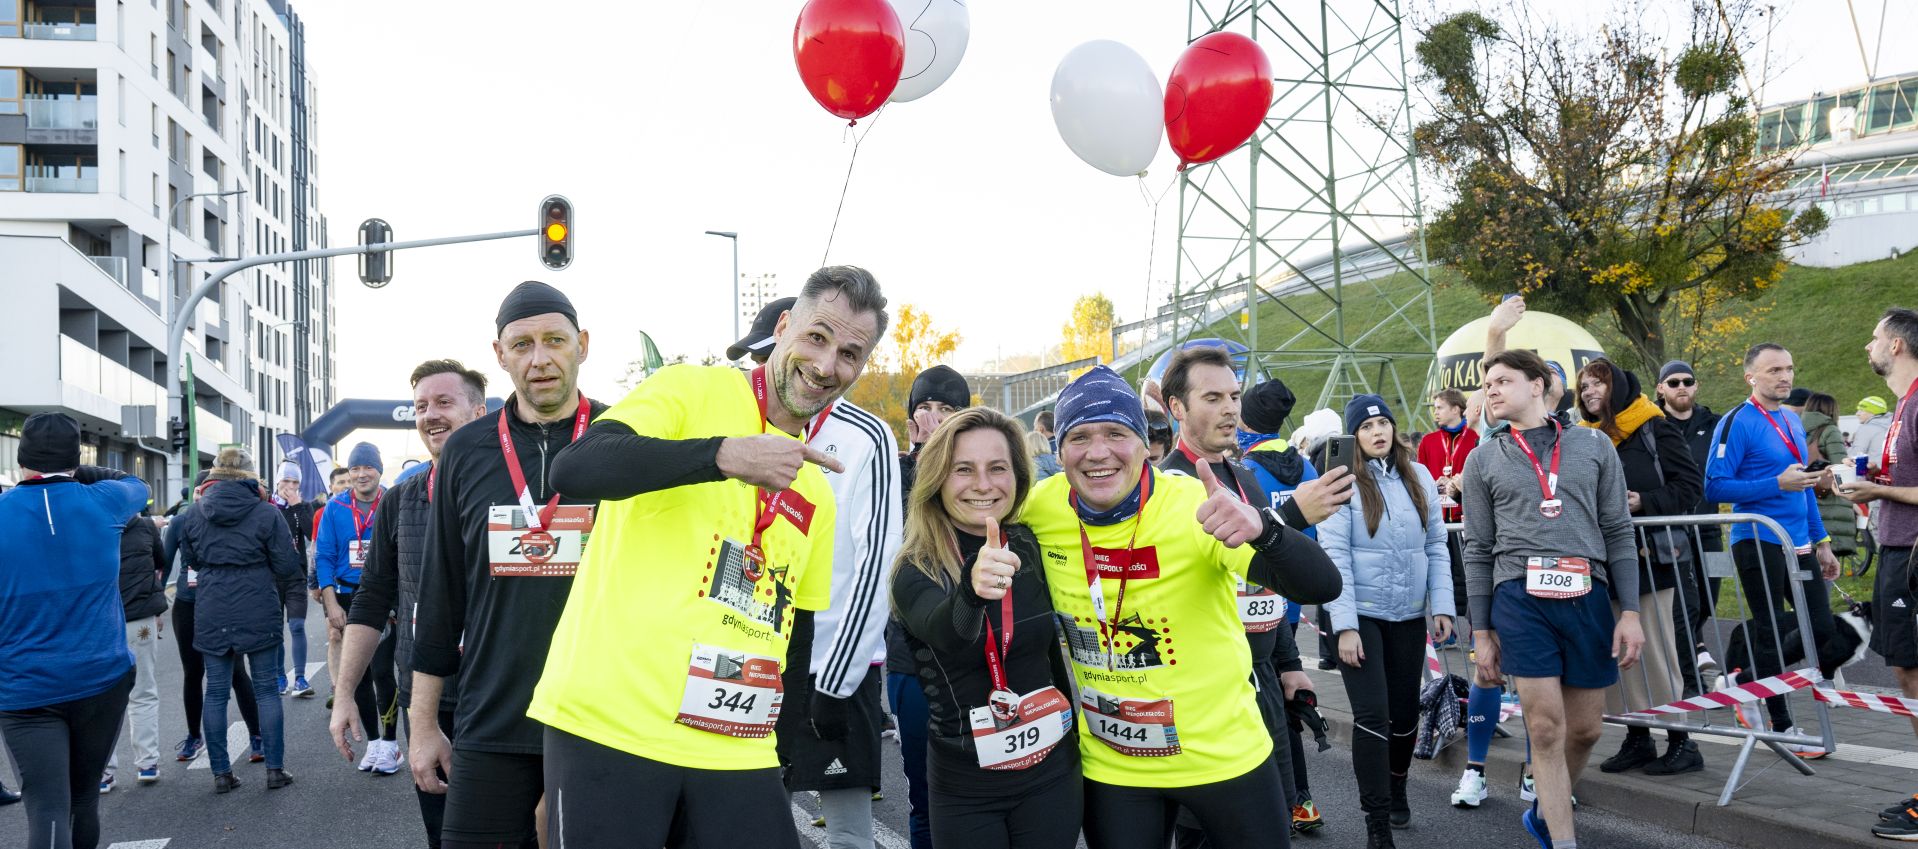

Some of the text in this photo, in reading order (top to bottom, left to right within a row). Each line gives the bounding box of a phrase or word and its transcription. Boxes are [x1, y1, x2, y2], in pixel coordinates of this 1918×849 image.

[1047, 551, 1068, 561] GDYNIA
[1094, 554, 1109, 562] BIEG
[1539, 573, 1573, 587] 1308
[1247, 599, 1275, 616] 833
[722, 614, 774, 644] gdyniasport.
[1083, 671, 1148, 685] gdyniasport.pl
[708, 687, 757, 714] 344
[680, 717, 732, 732] gdyniasport.pl
[1099, 719, 1148, 742] 1444
[1004, 726, 1040, 754] 319
[824, 767, 848, 775] adidas
